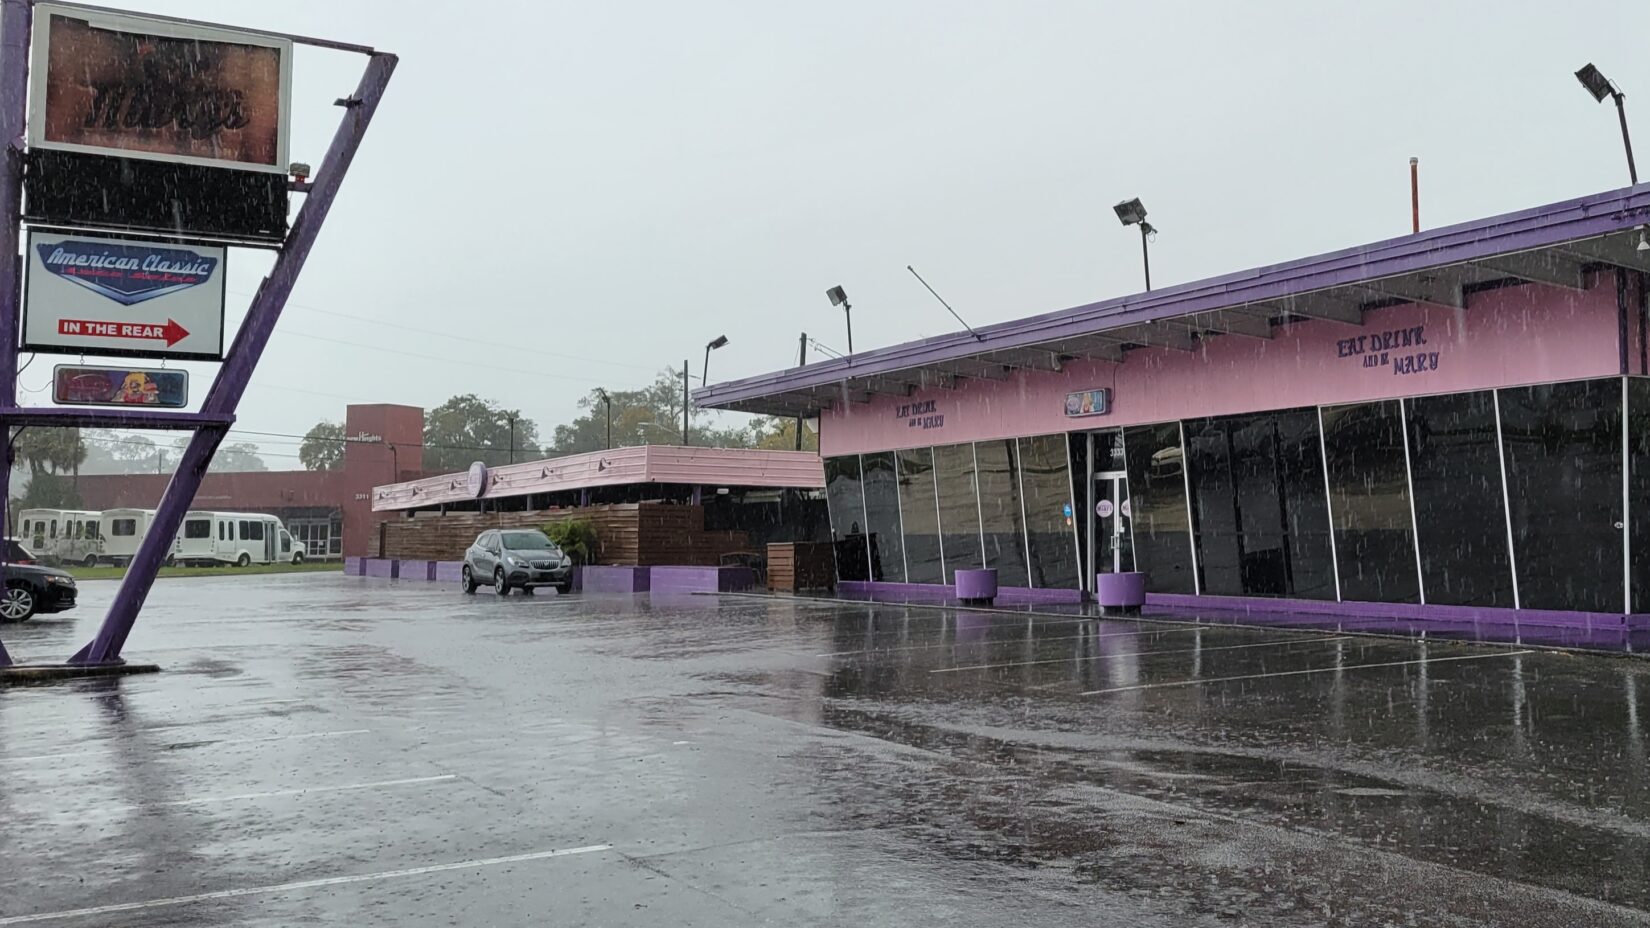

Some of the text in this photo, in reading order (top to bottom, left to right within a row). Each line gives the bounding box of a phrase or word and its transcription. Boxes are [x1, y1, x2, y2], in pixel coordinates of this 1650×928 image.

[47, 248, 139, 270] American
[141, 254, 209, 275] Classic
[63, 322, 163, 337] IN THE REAR
[1337, 326, 1427, 358] EAT DRINK
